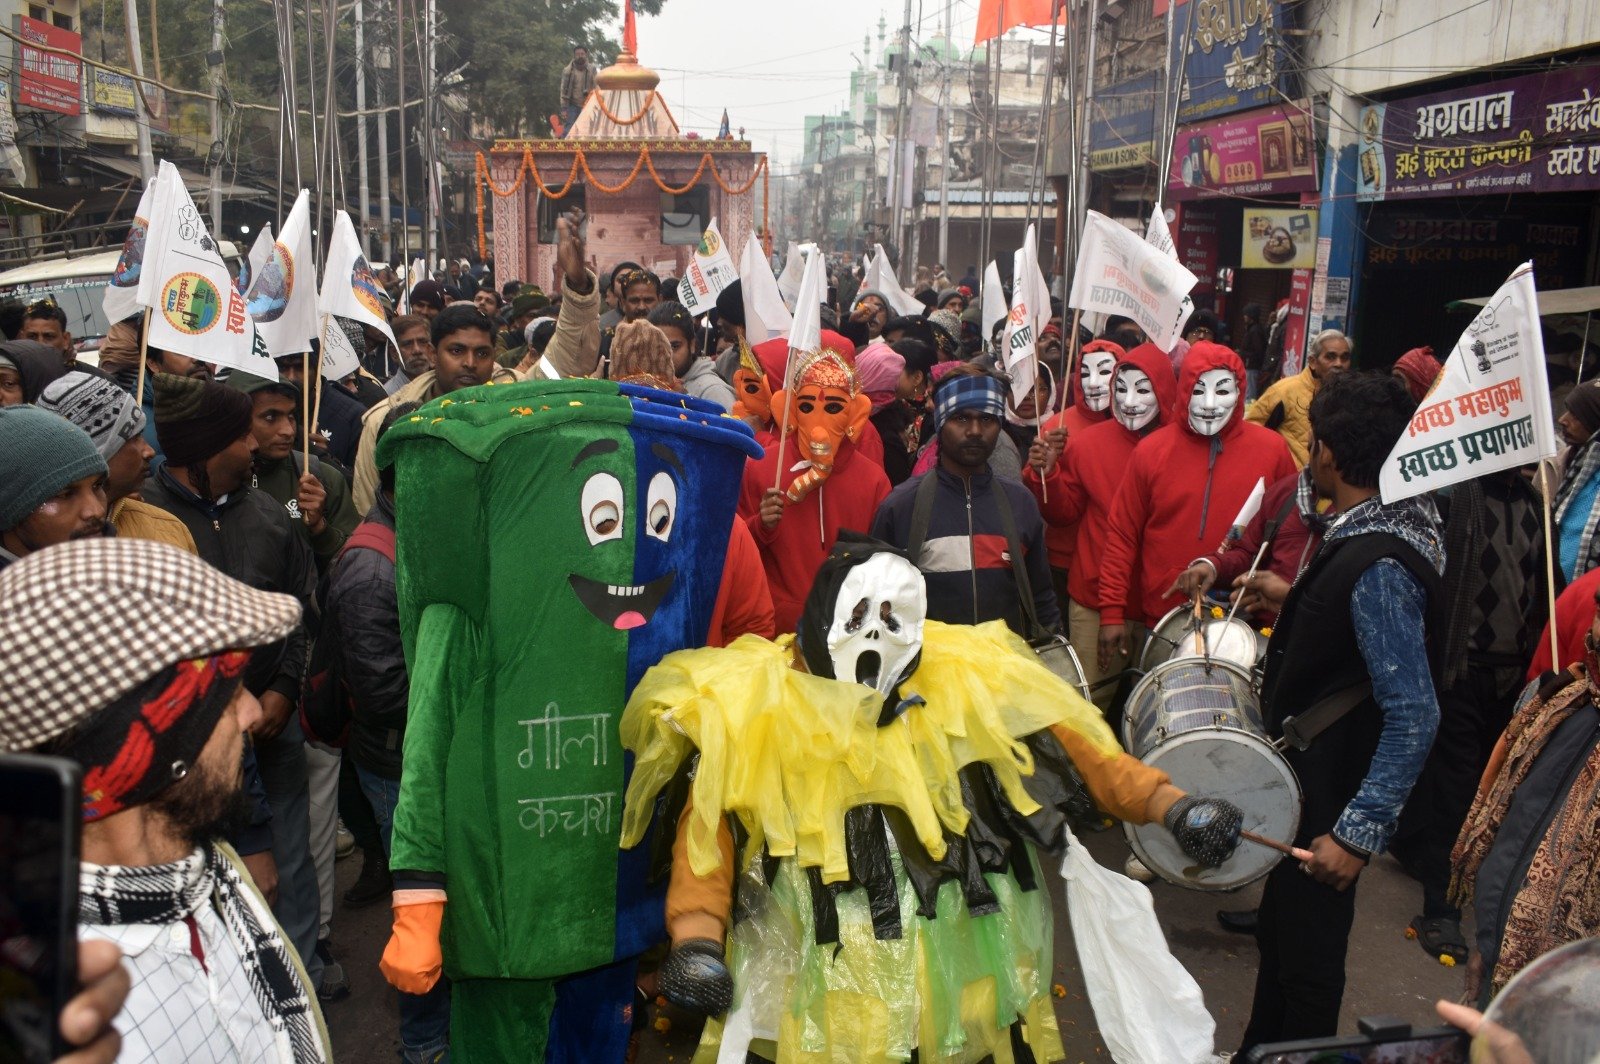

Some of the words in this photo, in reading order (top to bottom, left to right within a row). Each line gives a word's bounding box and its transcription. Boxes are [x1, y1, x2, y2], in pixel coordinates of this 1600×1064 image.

[24, 48, 38, 72] MOTI
[39, 53, 49, 76] LAL
[50, 56, 78, 83] FURNITURE
[1413, 91, 1514, 140] अग्रवाल
[1120, 147, 1138, 162] SONS
[1395, 144, 1420, 179] ड्राई
[1471, 129, 1534, 170] कम्पनी
[1182, 222, 1217, 234] Jewellery
[1186, 261, 1207, 272] Coins
[1187, 248, 1208, 258] Silver
[167, 289, 178, 312] स्वच्छ
[176, 277, 190, 313] महाकुम्भ
[1408, 398, 1455, 438] स्वच्छ
[1396, 438, 1458, 482] स्वच्छ
[1458, 414, 1535, 465] प्रयागराज
[517, 701, 612, 770] गीला
[517, 791, 617, 838] कचरा
